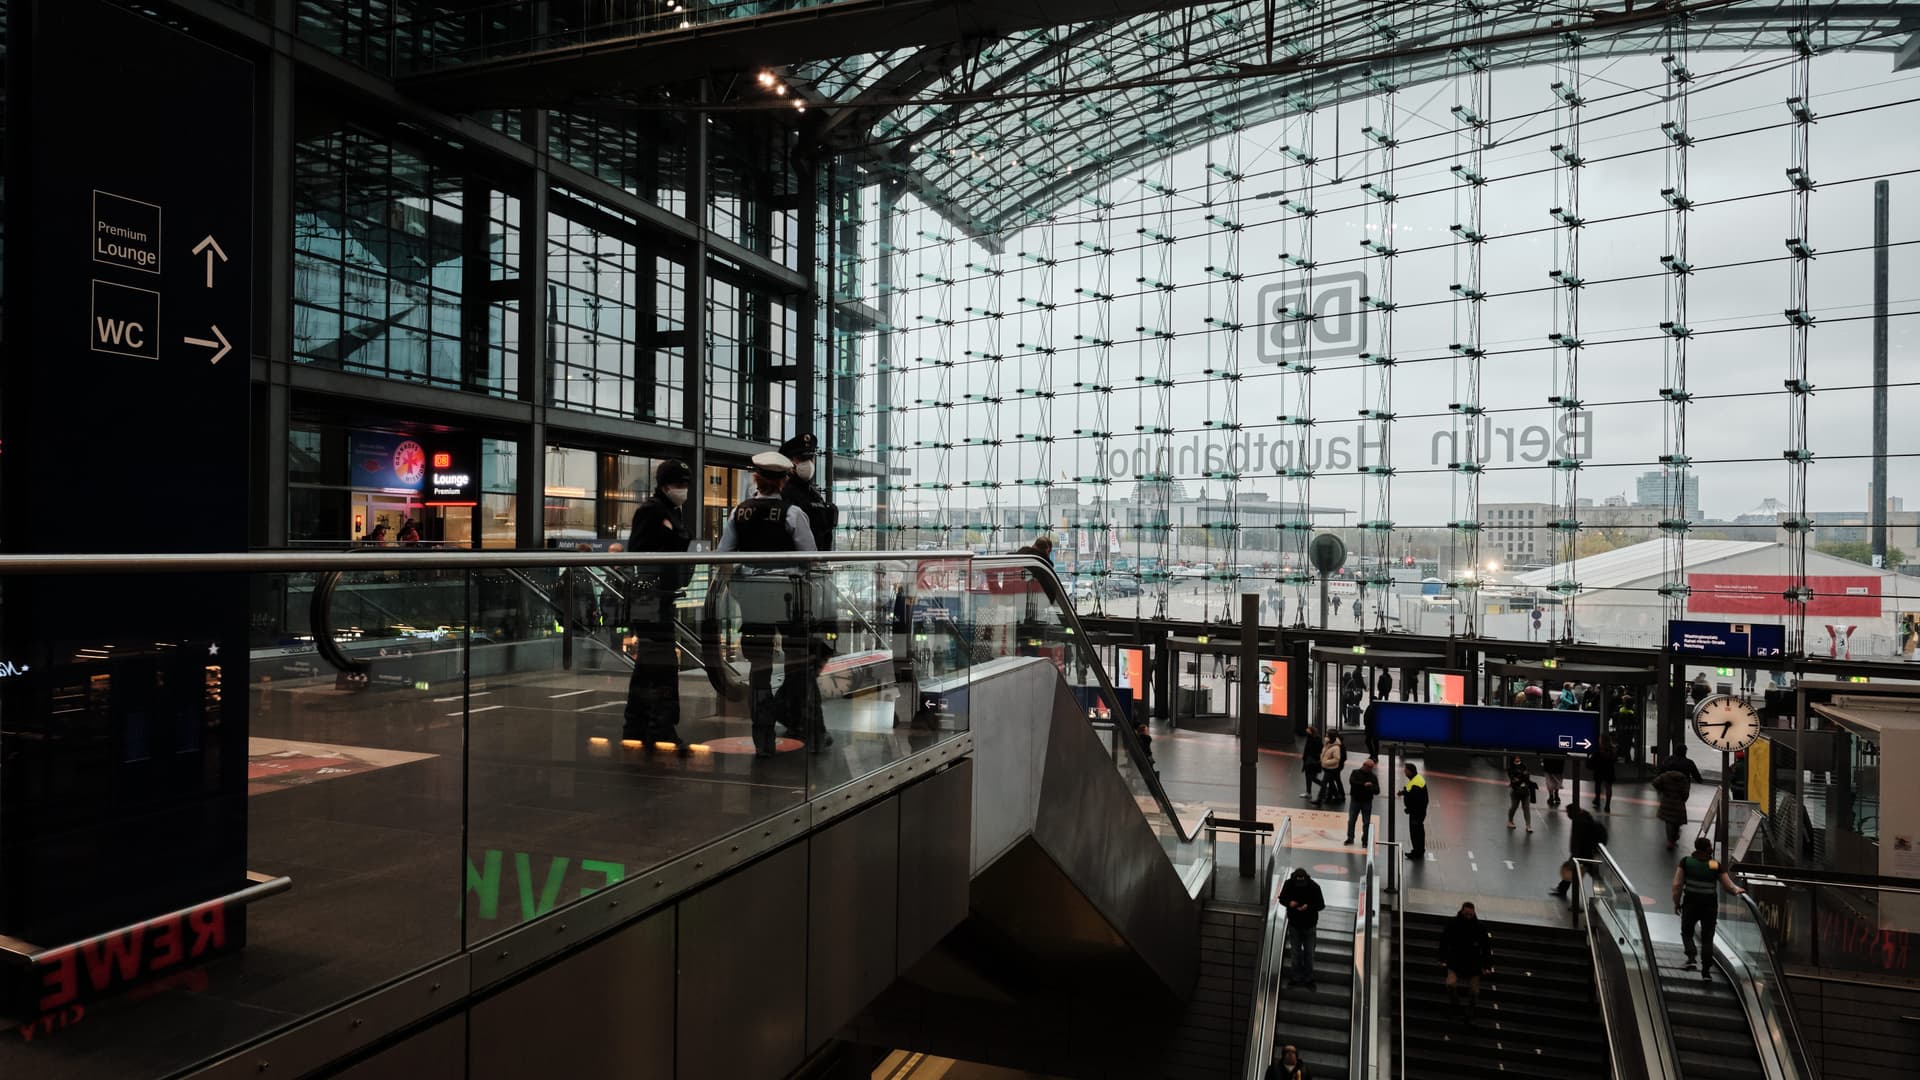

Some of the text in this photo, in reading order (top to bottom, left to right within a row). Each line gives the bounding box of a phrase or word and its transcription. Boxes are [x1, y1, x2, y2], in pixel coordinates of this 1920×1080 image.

[97, 220, 147, 243] Premium
[97, 237, 157, 266] Lounge
[97, 315, 145, 349] WC
[433, 473, 469, 487] Lounge
[434, 488, 461, 496] Premium
